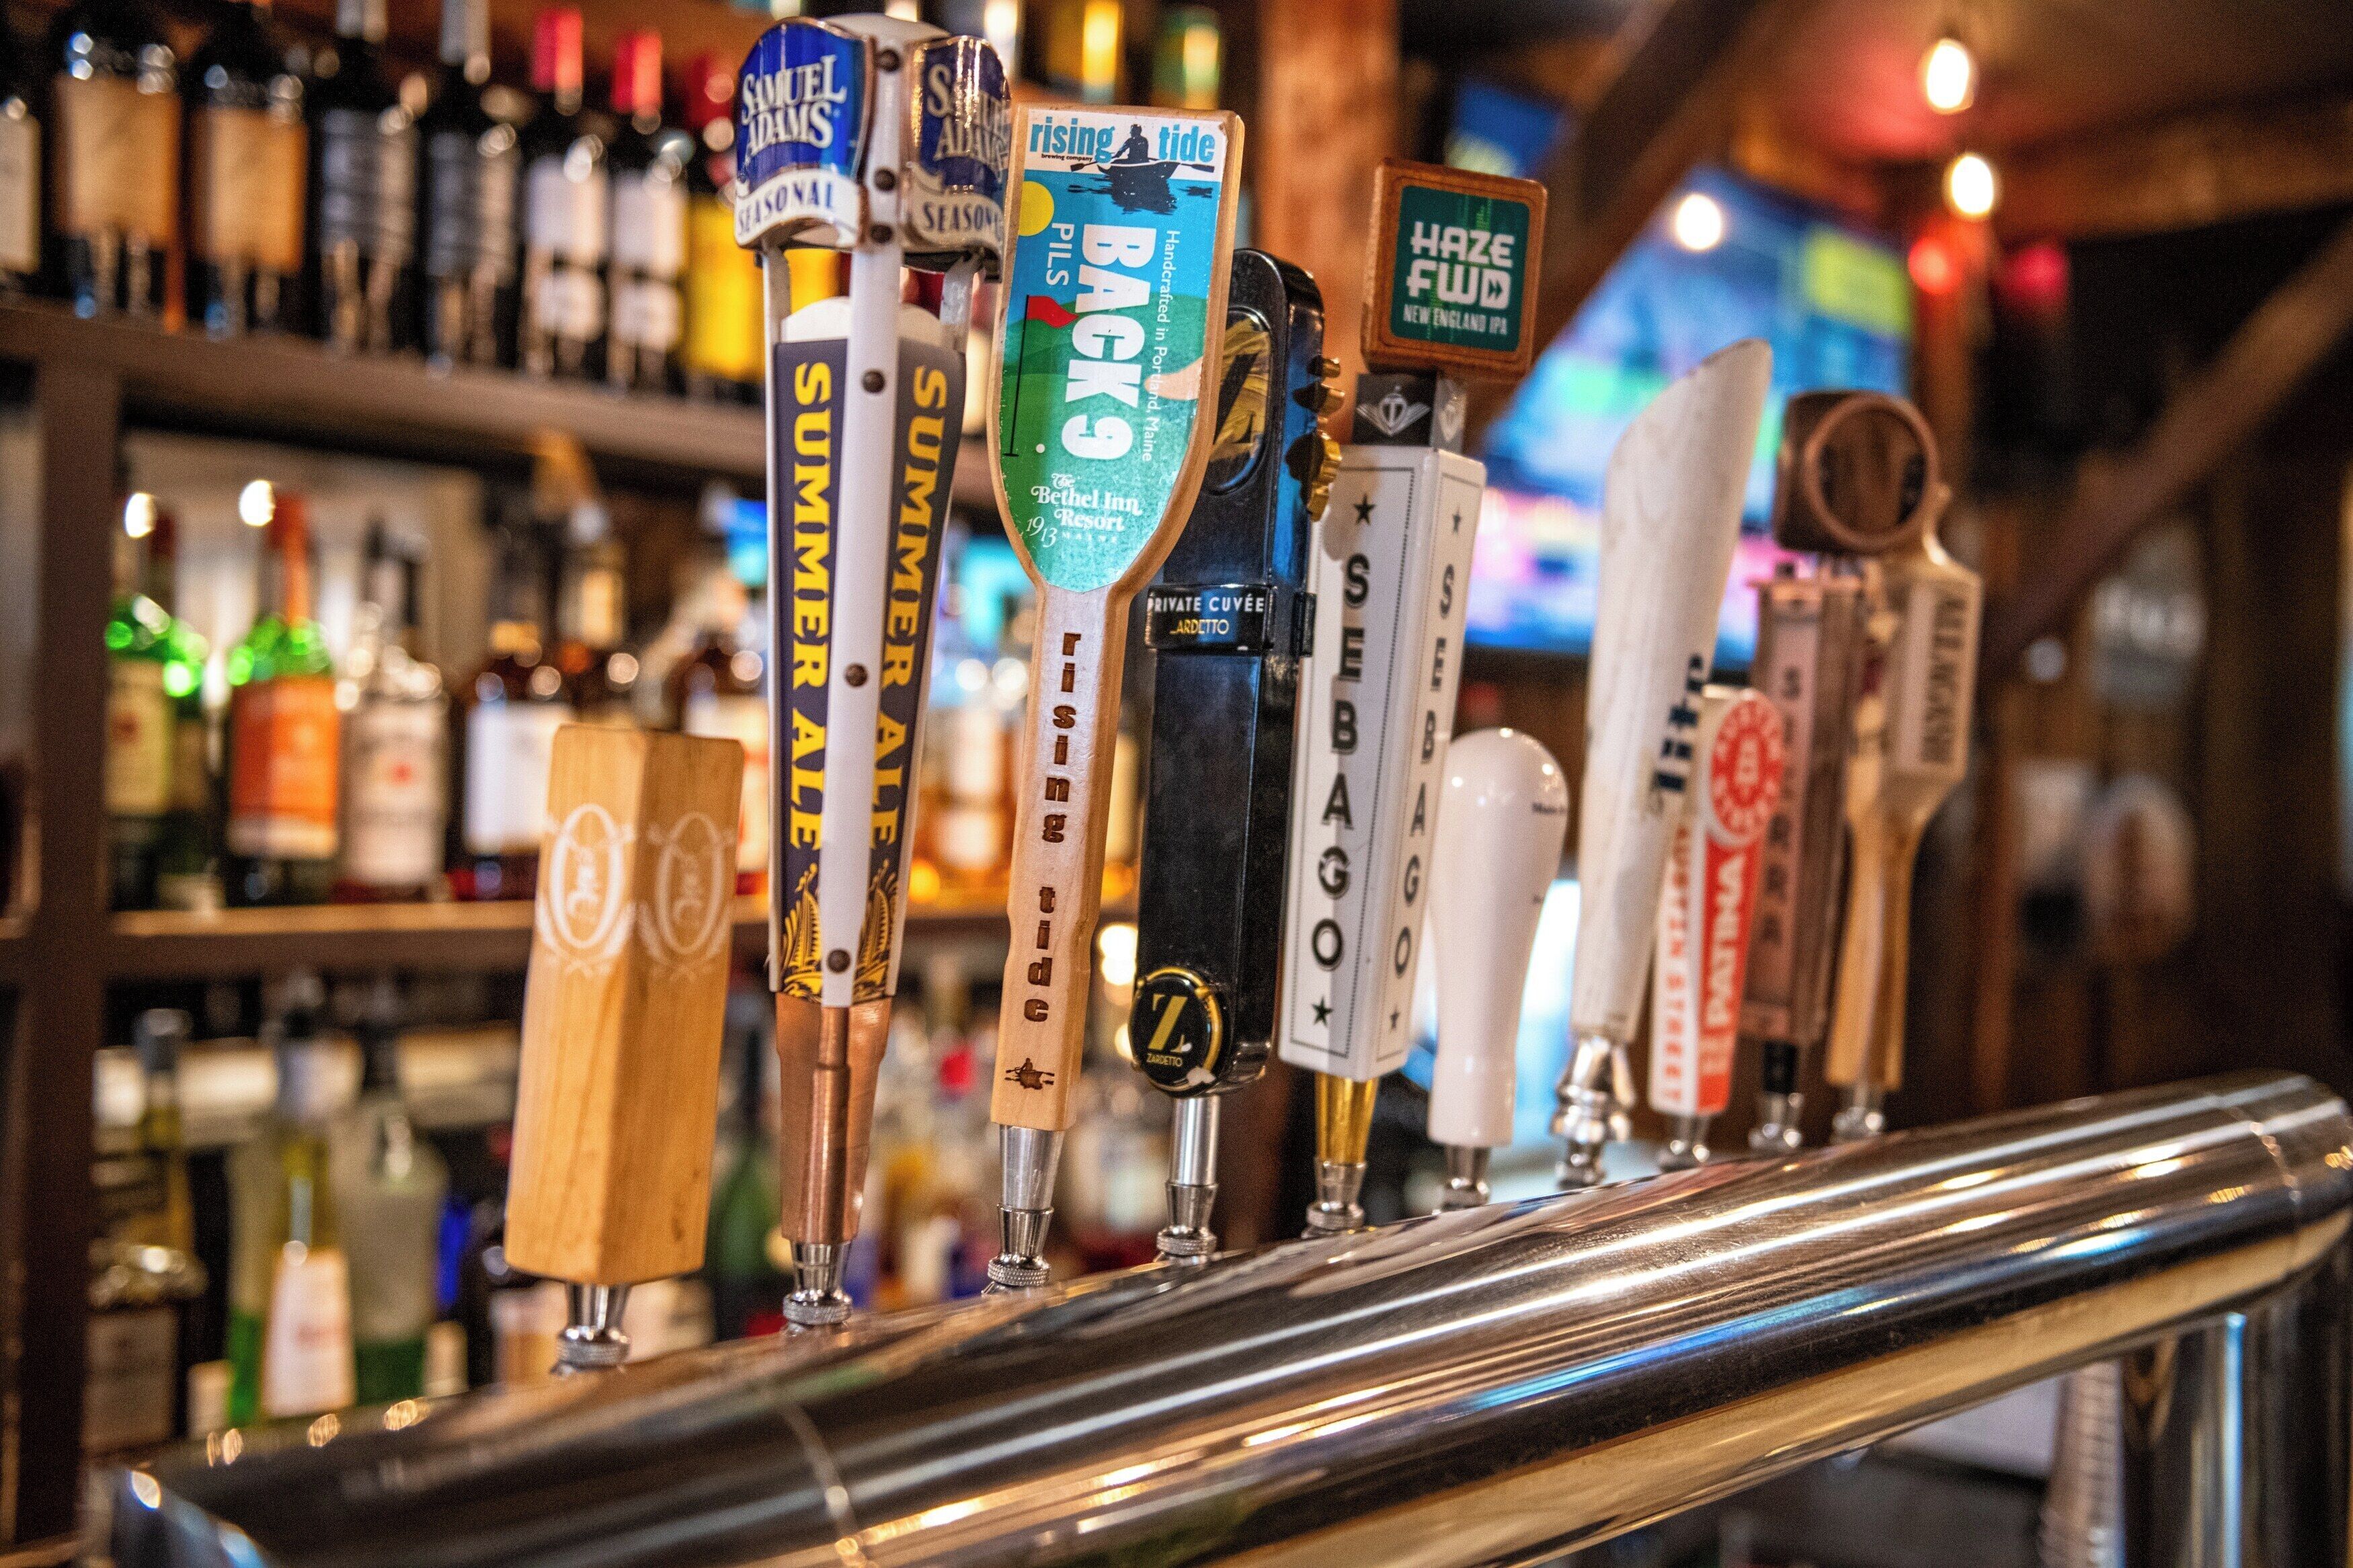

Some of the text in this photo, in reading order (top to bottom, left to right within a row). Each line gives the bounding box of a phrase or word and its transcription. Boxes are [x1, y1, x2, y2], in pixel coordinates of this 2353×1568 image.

[741, 54, 847, 126] SAMUEL
[745, 101, 835, 166] ADAMS
[1029, 116, 1216, 163] rising tide
[738, 177, 835, 237] SEASONAL
[1045, 222, 1075, 286] PILS
[1410, 220, 1515, 267] HAZE
[1406, 259, 1512, 310] FWD
[1061, 224, 1157, 460] BACK 9
[1142, 230, 1181, 462] Handcrafted in Portland, Maine
[1402, 303, 1508, 335] NEW ENGLAND IPA
[1031, 485, 1143, 517] Bethel Inn
[1051, 473, 1075, 489] The
[793, 361, 833, 690] SUMMER
[881, 364, 948, 692] SUMMER
[1053, 508, 1125, 532] Resort
[1147, 593, 1265, 612] PRIVATE CUVÉE
[1042, 632, 1082, 844] rising
[1311, 553, 1370, 972] SEBAGO
[790, 707, 826, 851] ALE
[871, 708, 908, 850] ALE
[1393, 563, 1455, 980] SEBAGO
[1023, 886, 1055, 1023] tide
[1148, 993, 1189, 1053] Z
